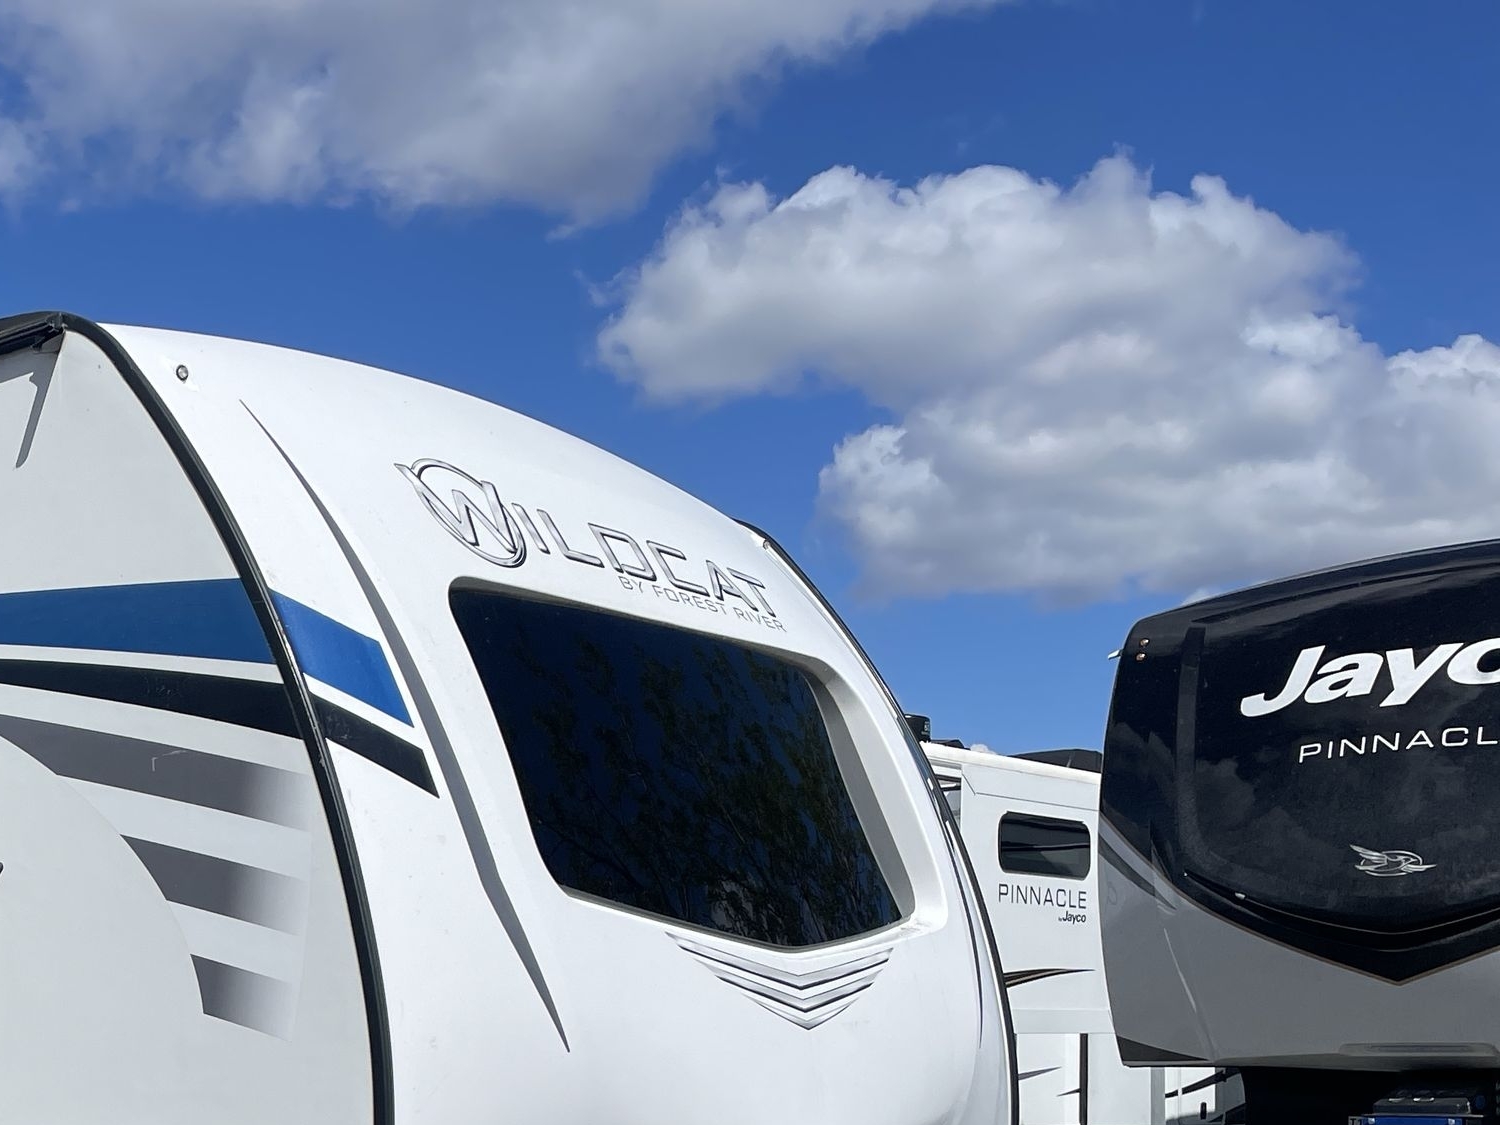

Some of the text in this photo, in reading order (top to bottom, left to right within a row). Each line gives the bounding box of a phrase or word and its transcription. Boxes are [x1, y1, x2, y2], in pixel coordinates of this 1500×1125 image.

[394, 458, 777, 618] WILDCAT
[618, 575, 788, 633] BY FOREST RIVER
[1298, 726, 1498, 763] PINNACL
[998, 883, 1087, 909] PINNACLE
[1062, 910, 1087, 925] Jayco
